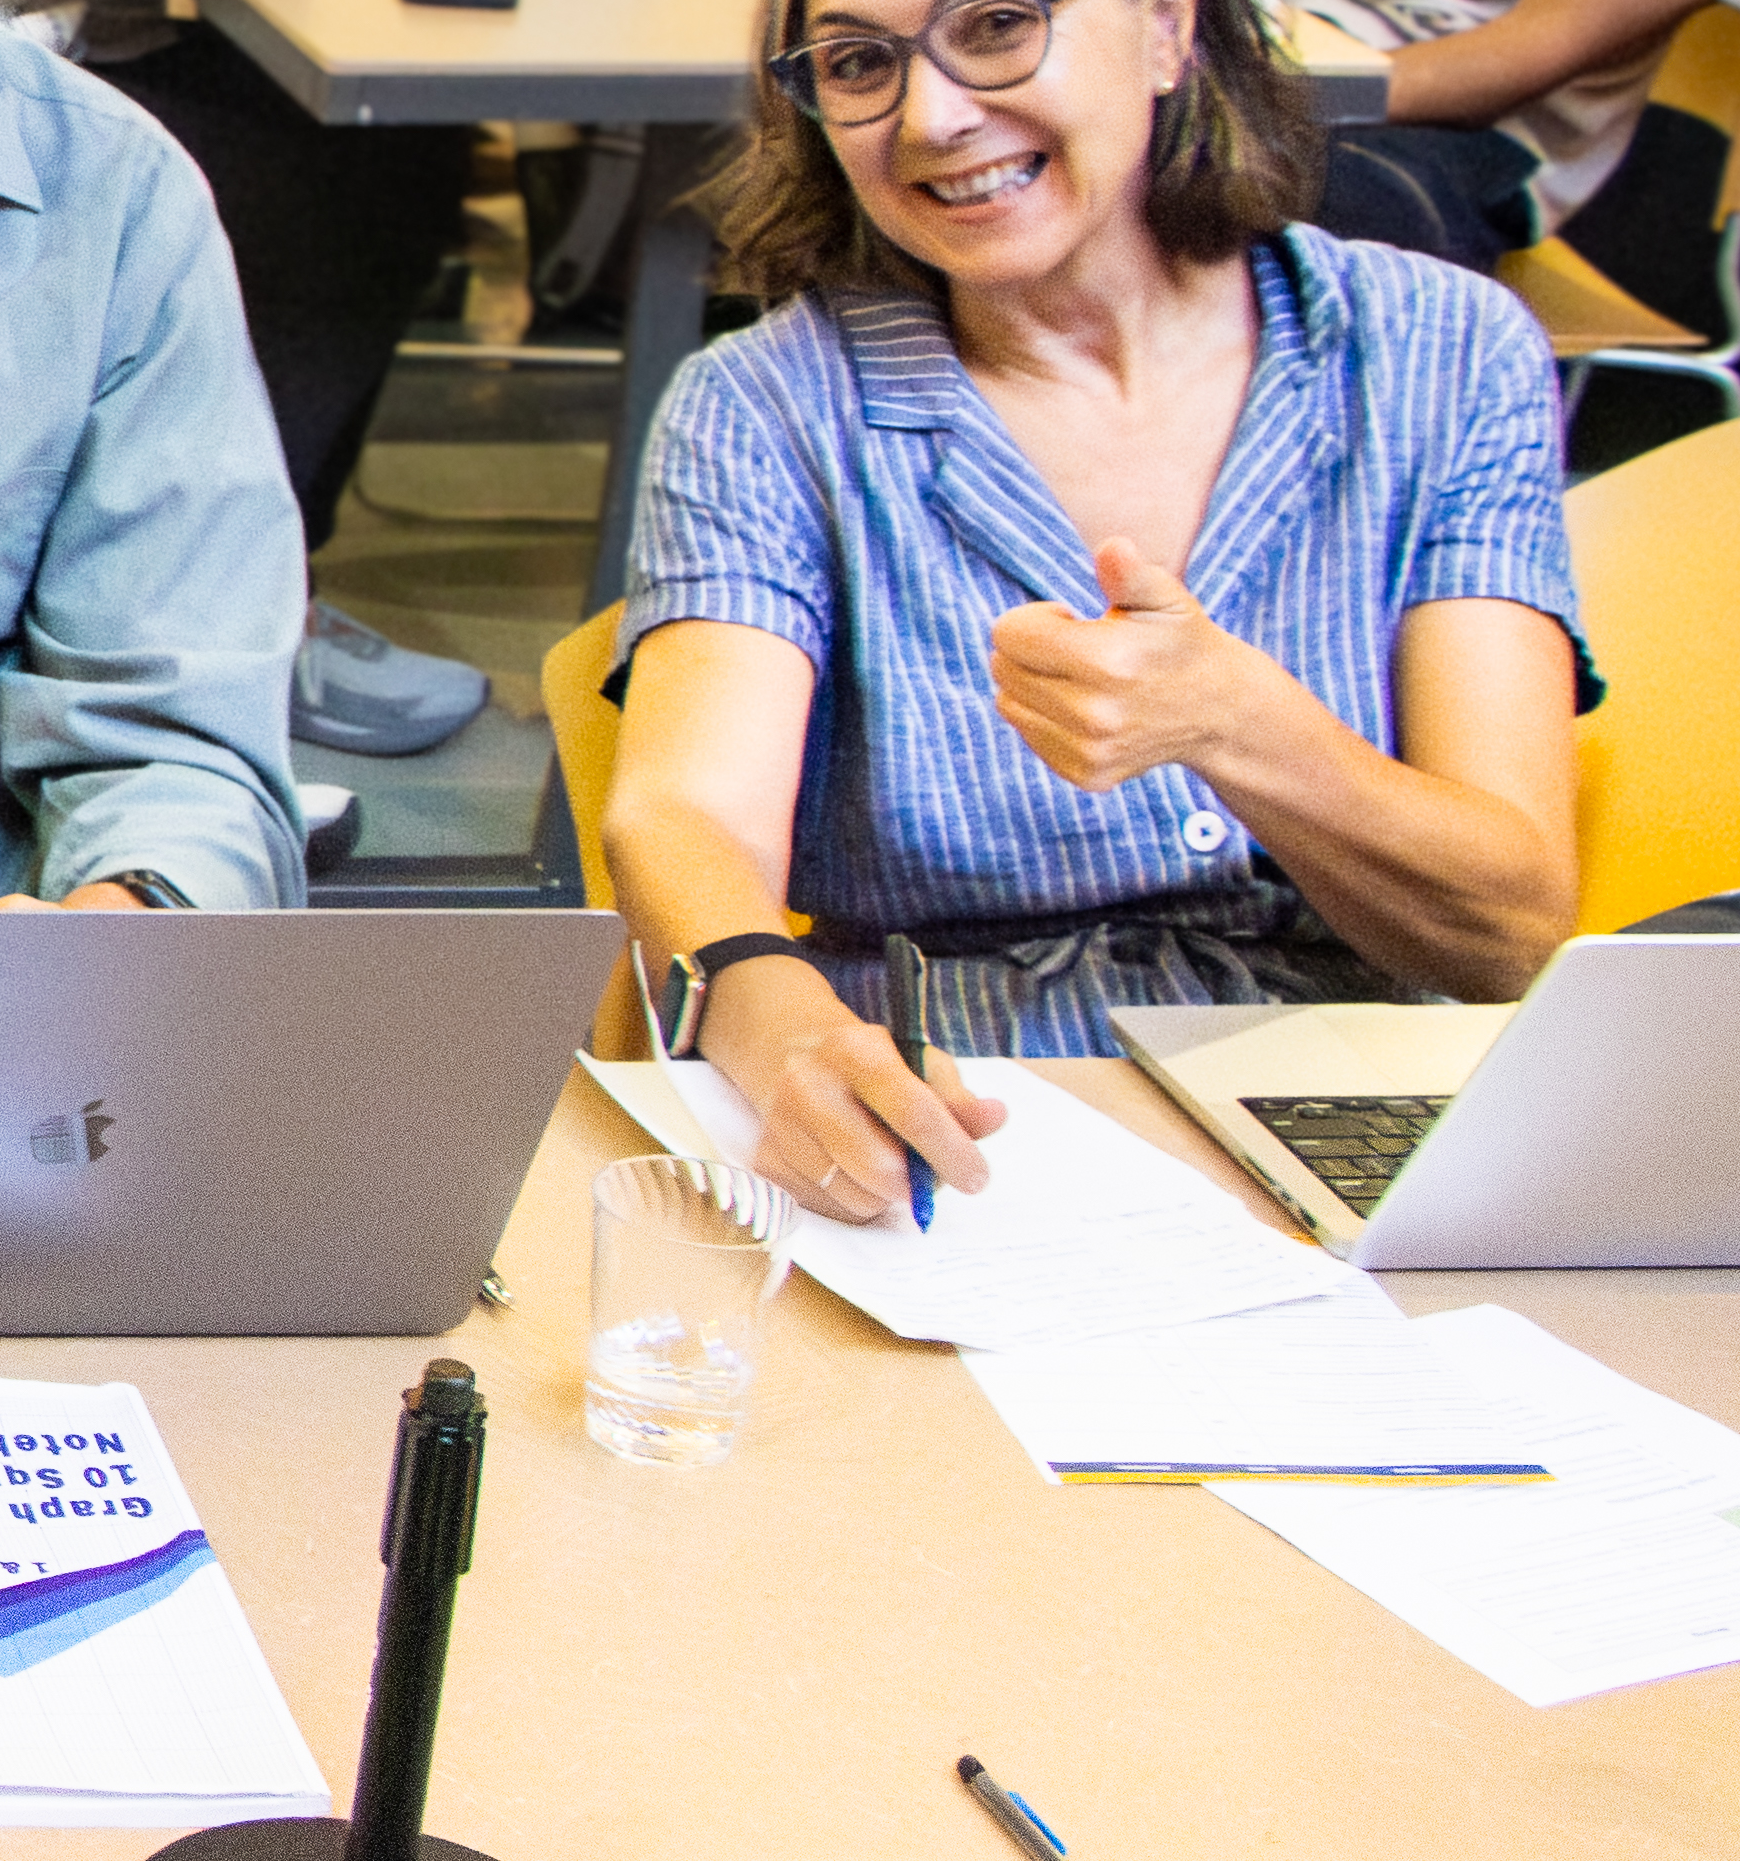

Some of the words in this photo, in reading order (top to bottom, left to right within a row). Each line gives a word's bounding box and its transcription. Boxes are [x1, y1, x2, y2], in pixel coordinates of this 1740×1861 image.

[83, 1462, 139, 1489] 10
[8, 1496, 154, 1522] Graph
[0, 1561, 21, 1574] &
[31, 1561, 50, 1574] 1
